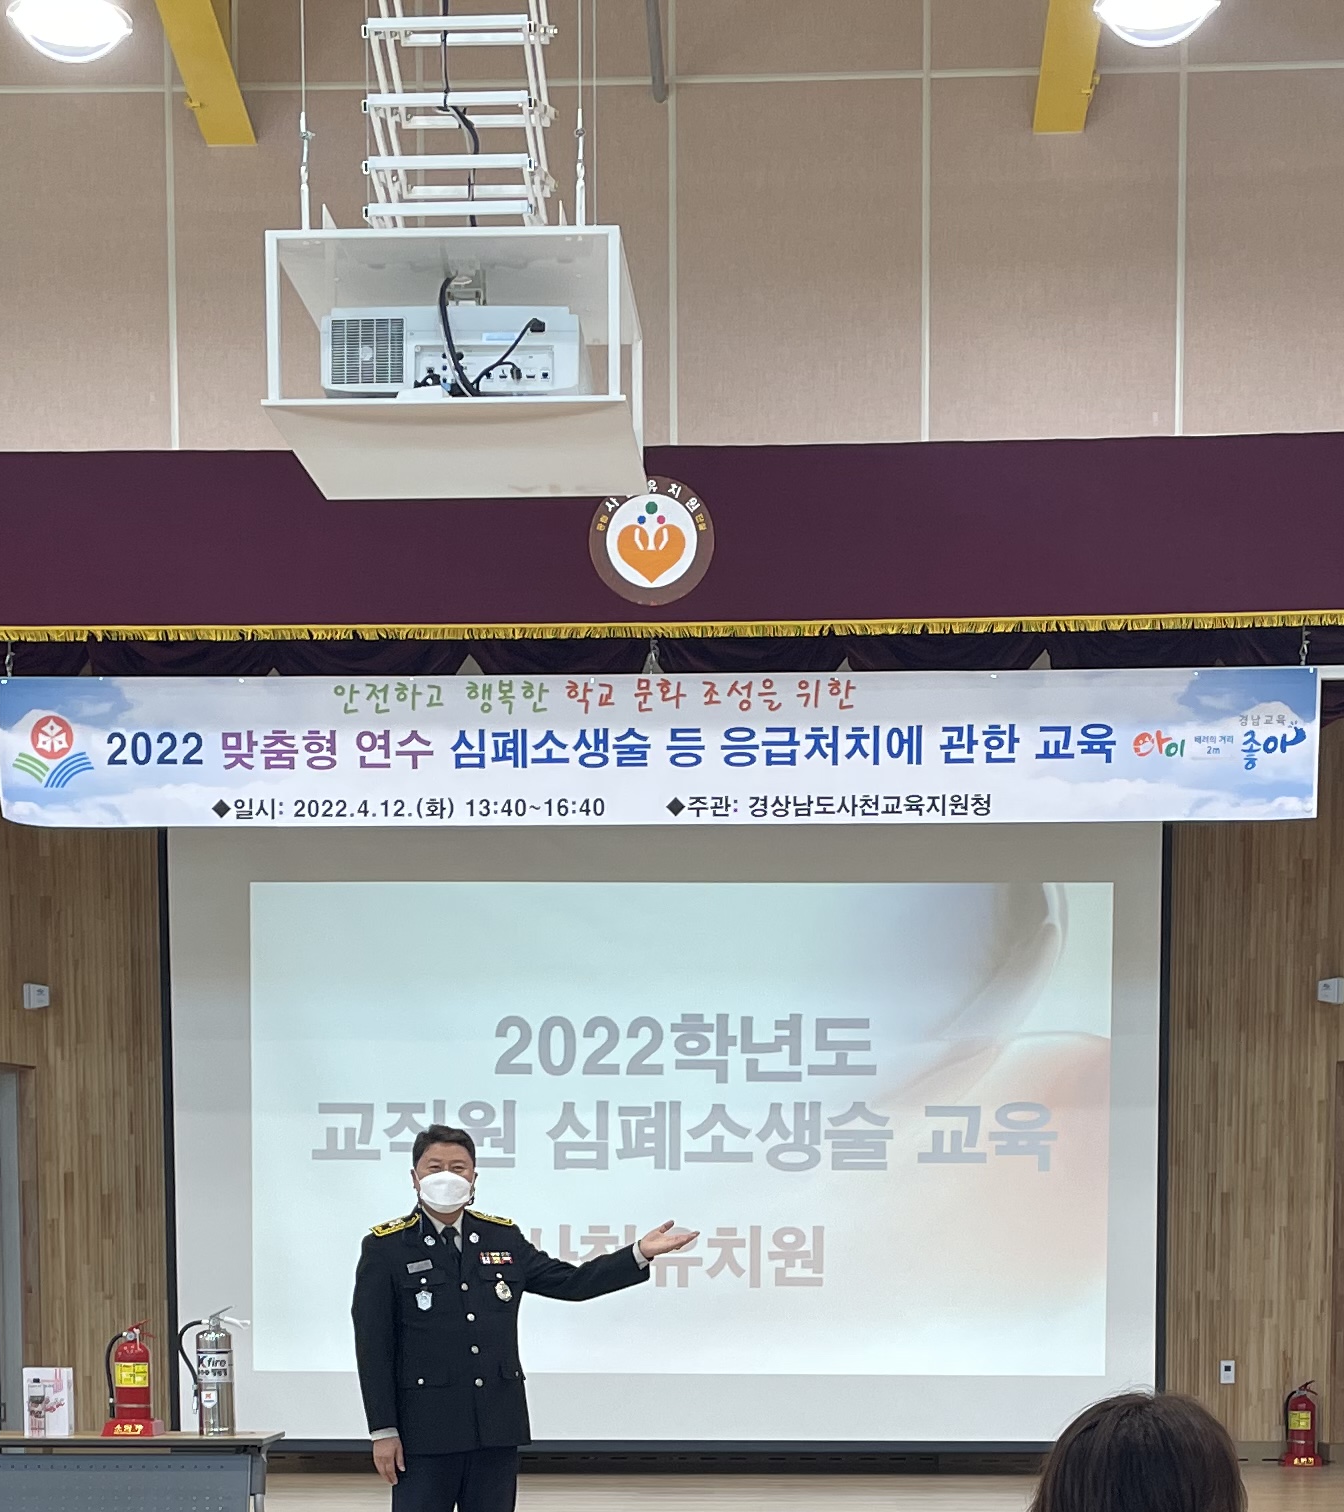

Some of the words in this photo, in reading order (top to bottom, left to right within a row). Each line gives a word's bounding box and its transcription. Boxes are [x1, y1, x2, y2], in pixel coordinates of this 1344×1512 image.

[333, 681, 444, 714] 안전하고
[465, 680, 550, 713] 행복한
[567, 678, 616, 713] 학교
[633, 678, 685, 712] 문화
[702, 678, 783, 711] 조성을
[797, 677, 856, 711] 위한
[106, 731, 204, 768] 2022
[221, 727, 340, 769] 맞춤형
[357, 727, 435, 769] 연수
[450, 725, 653, 769] 심폐소생술
[666, 725, 706, 768] 등
[721, 723, 925, 768] 응급처치에
[939, 722, 1021, 766] 관한
[1034, 722, 1118, 764] 교육
[1206, 746, 1221, 755] 2m
[1241, 726, 1307, 771] 좋아
[293, 797, 455, 821] 2022.4.12.(화)
[466, 797, 606, 819] 13:40~16:40
[747, 793, 992, 818] 경상남도사천교육지원청
[494, 1013, 878, 1083] 2022학년도
[547, 1100, 891, 1171] 심폐소생술
[918, 1101, 1057, 1171] 교육
